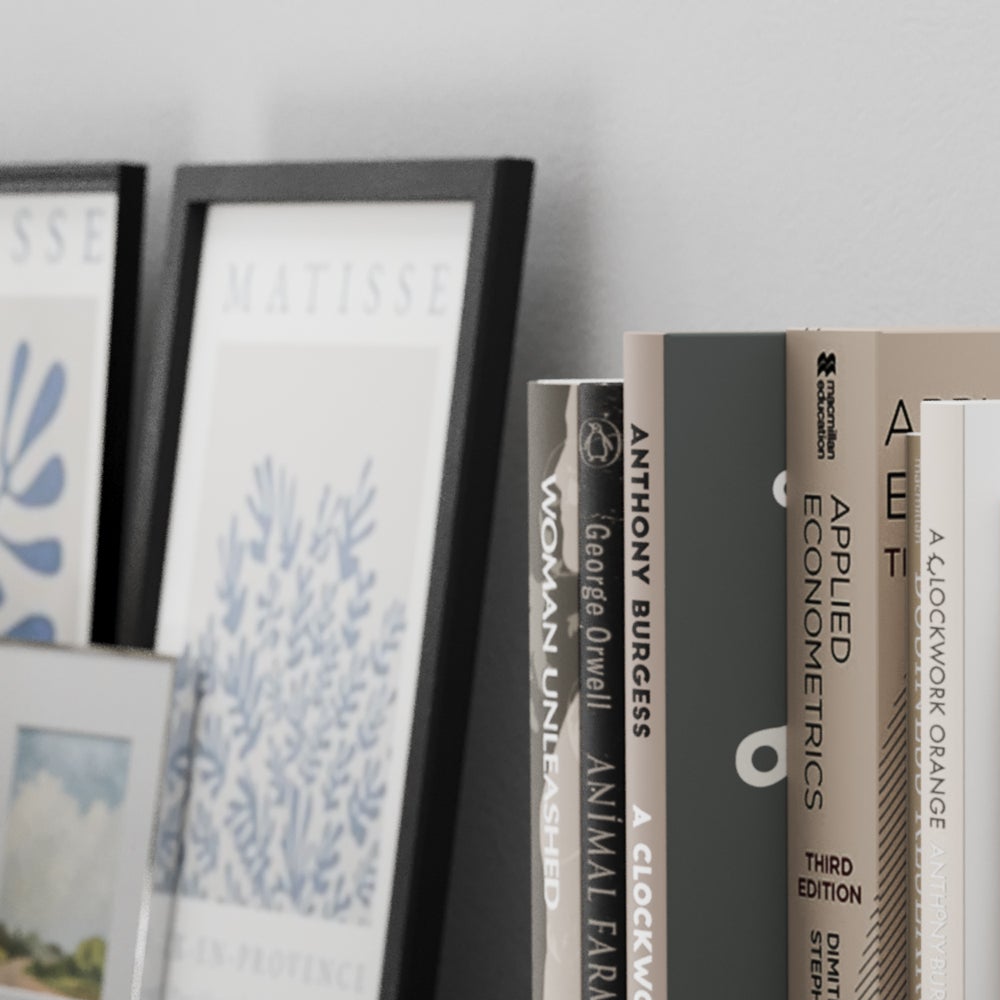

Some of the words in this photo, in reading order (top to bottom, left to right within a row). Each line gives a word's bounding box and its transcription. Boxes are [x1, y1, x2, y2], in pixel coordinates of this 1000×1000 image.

[8, 206, 106, 265] SSE
[220, 261, 453, 316] MATISSE
[631, 424, 650, 584] ANTHONY
[929, 528, 946, 545] A
[541, 475, 558, 653] WOMAN
[581, 523, 612, 617] George
[829, 493, 852, 664] APPLIED
[586, 626, 612, 710] Orwell
[632, 600, 651, 738] BURGESS
[804, 494, 822, 809] ECONOMETRICS
[927, 551, 947, 716] CLOCKWORK
[541, 668, 560, 909] UNLEASHED
[631, 804, 652, 828] A
[928, 724, 947, 829] ORANGE
[798, 877, 862, 905] EDITION
[805, 852, 853, 876] THIRD
